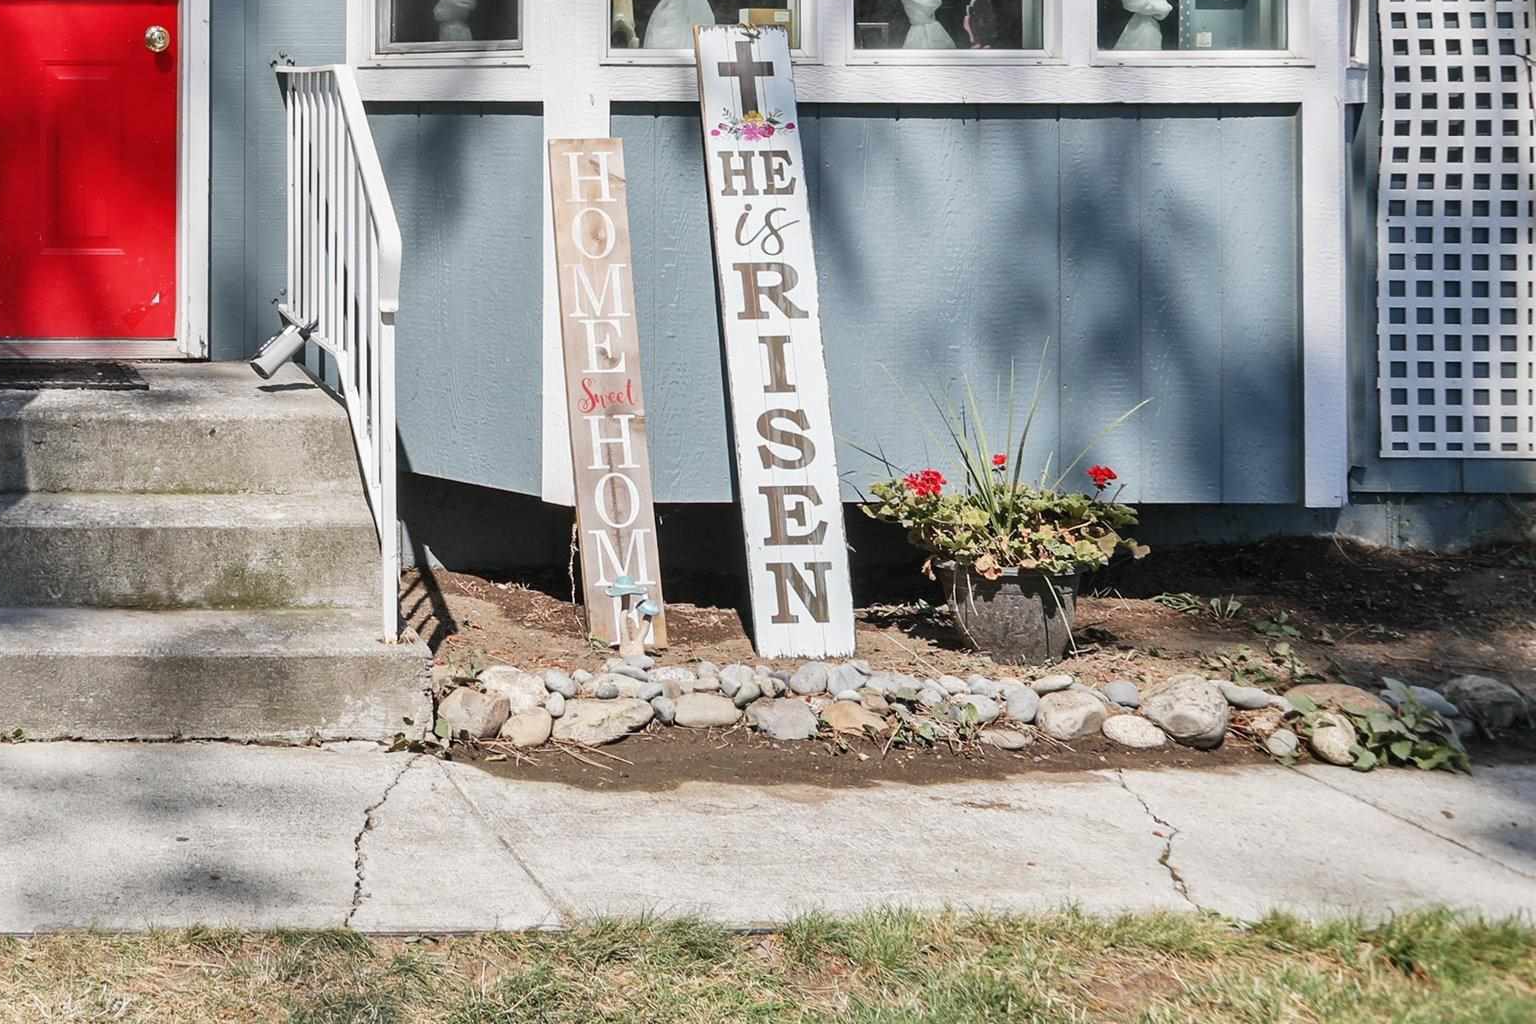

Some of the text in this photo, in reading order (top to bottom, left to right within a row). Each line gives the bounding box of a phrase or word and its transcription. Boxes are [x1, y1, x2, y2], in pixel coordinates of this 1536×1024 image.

[717, 150, 796, 196] HE
[734, 203, 800, 256] is
[561, 151, 632, 373] HOME
[577, 377, 636, 414] Sweet
[732, 262, 833, 624] RISEN
